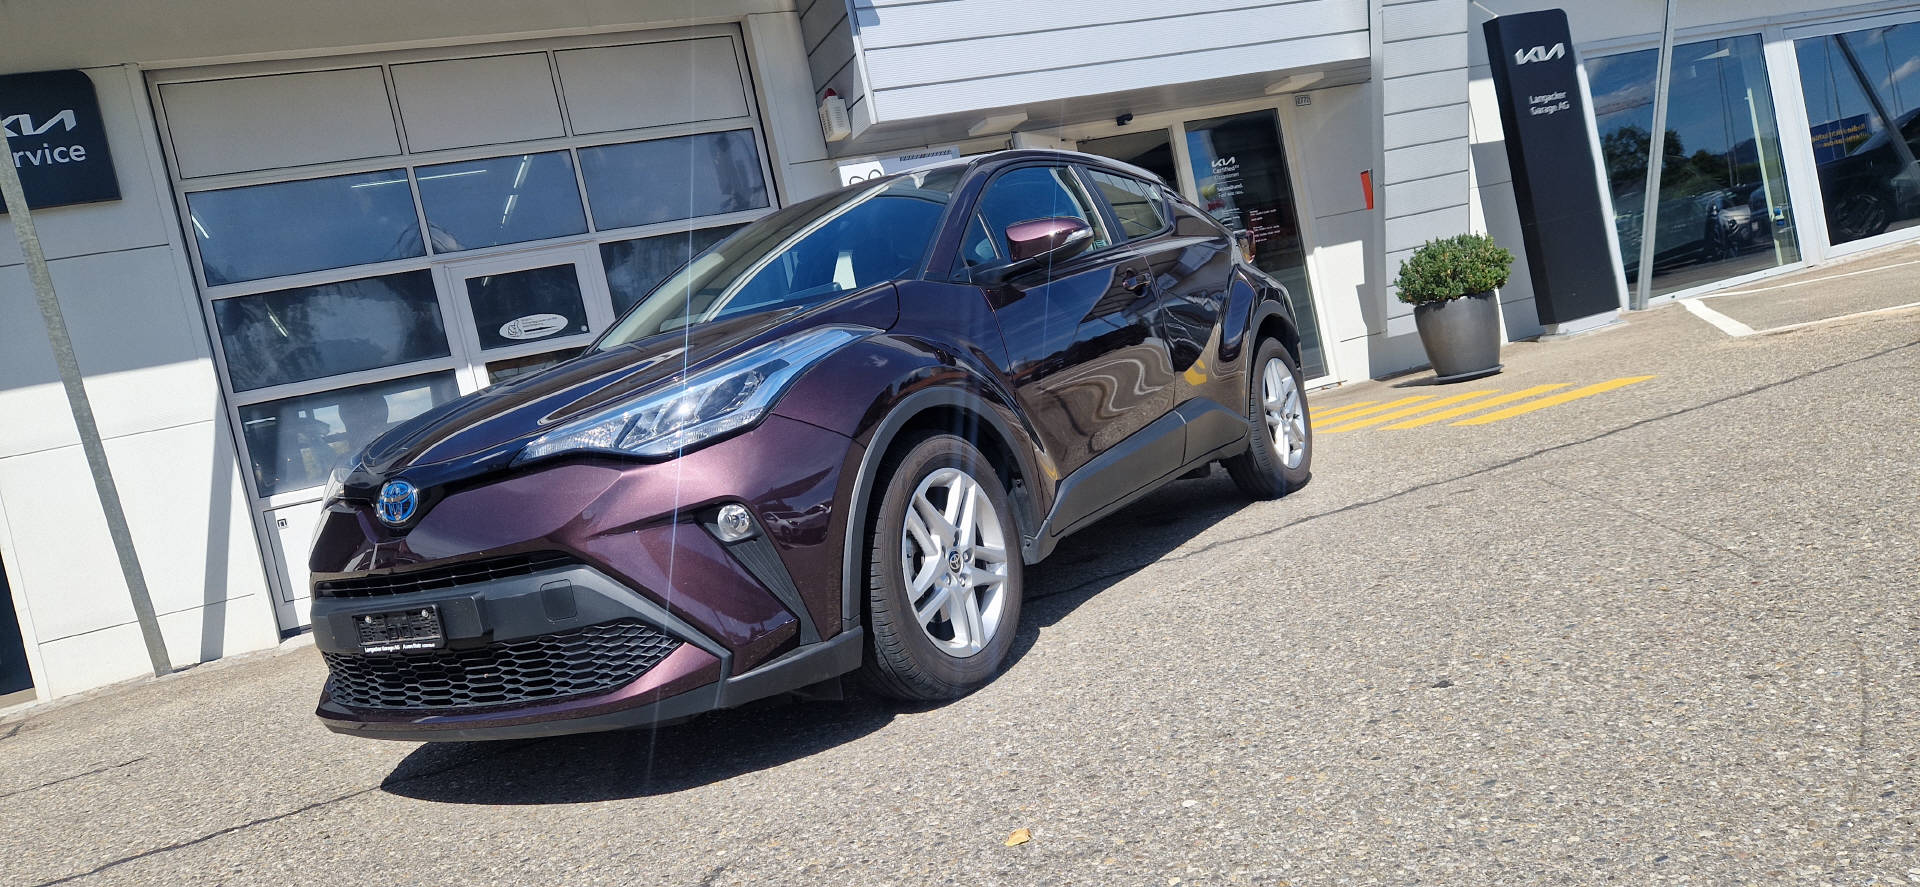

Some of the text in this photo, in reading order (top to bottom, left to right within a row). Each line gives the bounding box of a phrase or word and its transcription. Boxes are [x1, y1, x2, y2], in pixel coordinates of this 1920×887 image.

[1515, 42, 1565, 65] KIA
[1529, 91, 1567, 104] Langacker
[1529, 100, 1570, 116] Garage AG
[12, 143, 87, 168] rvice
[1211, 156, 1236, 168] KIA
